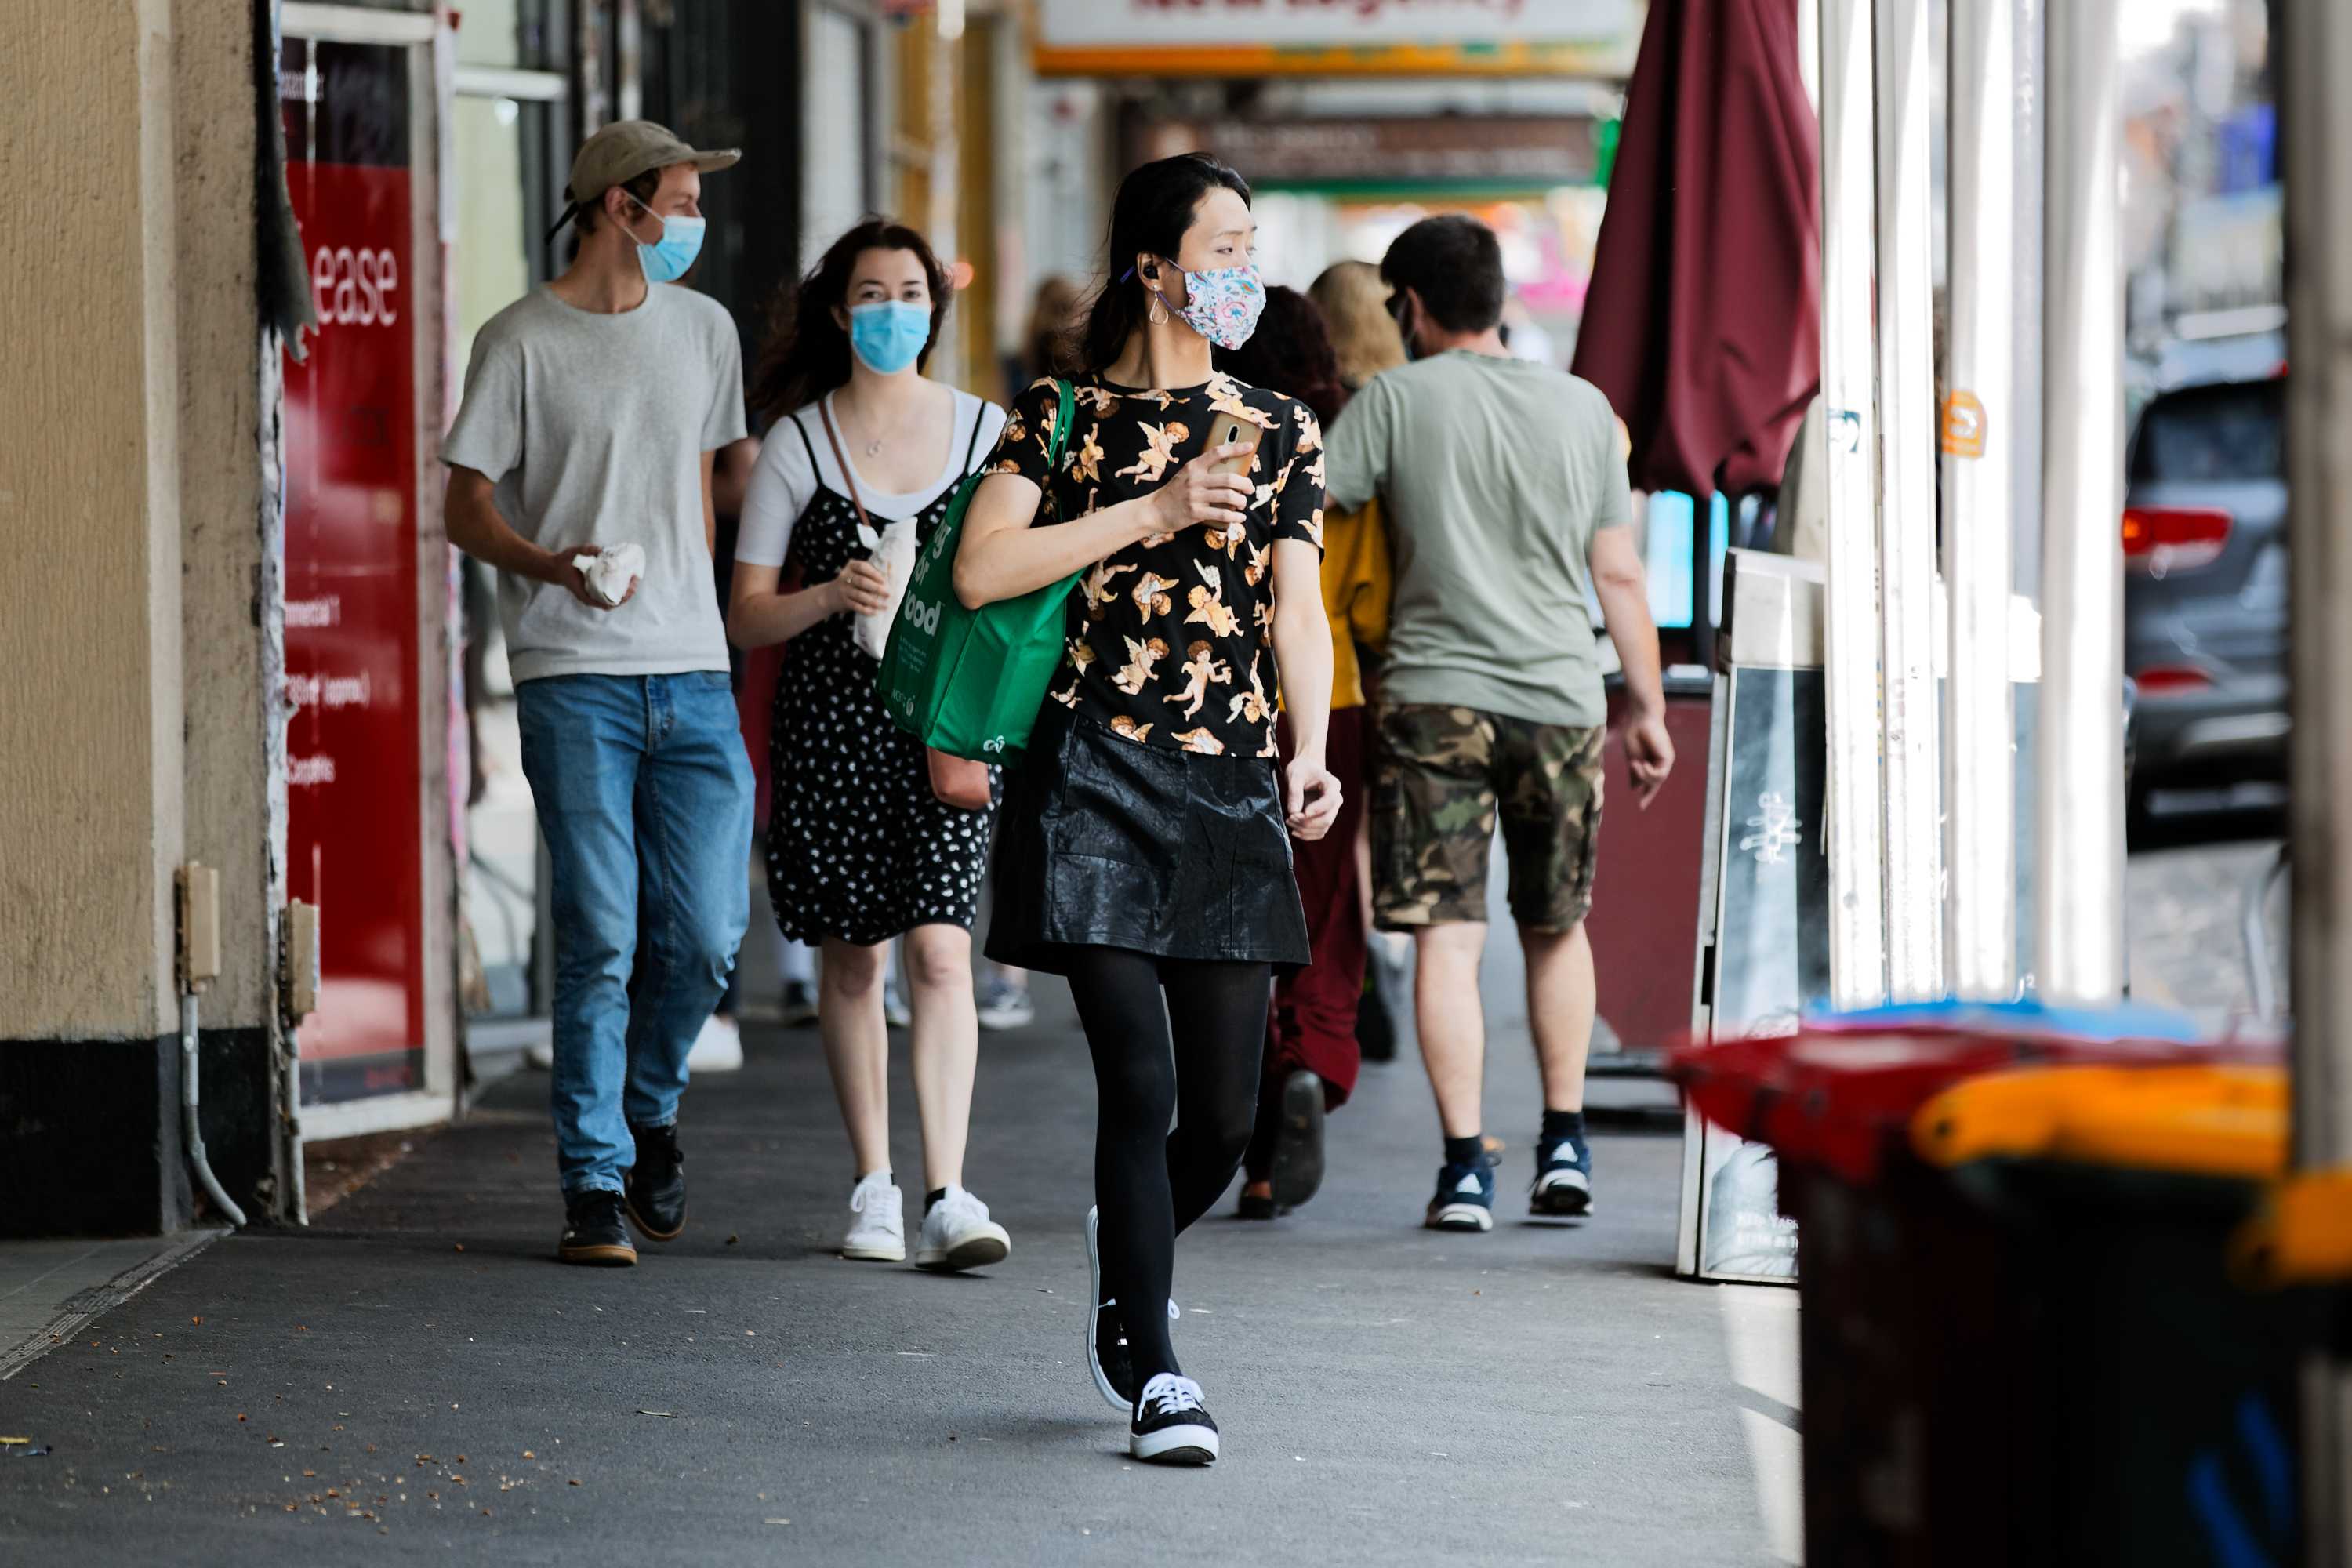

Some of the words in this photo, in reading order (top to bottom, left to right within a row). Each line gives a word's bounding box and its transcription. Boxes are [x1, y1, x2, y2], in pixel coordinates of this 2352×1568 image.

[313, 245, 397, 327] ease
[915, 551, 930, 586] or
[904, 589, 942, 637] ood
